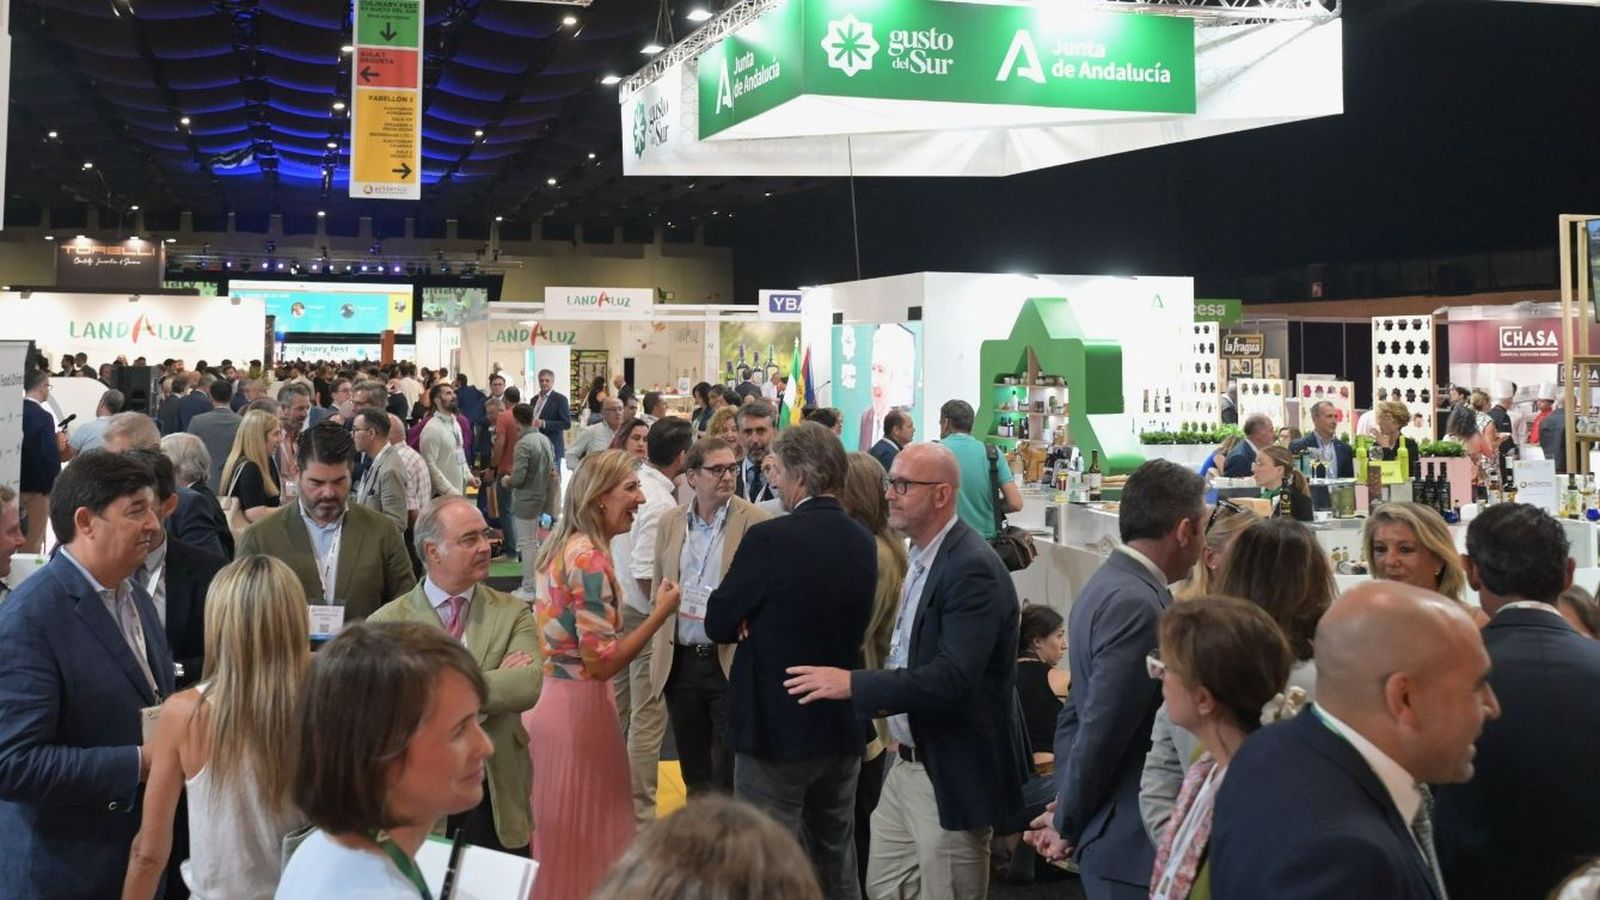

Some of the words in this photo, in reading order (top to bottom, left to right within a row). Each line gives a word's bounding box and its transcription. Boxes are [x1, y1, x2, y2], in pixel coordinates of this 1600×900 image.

[888, 27, 954, 56] gusto
[1052, 38, 1107, 58] Junta
[733, 51, 755, 75] Junta
[892, 57, 909, 69] del
[909, 50, 954, 74] Sur
[1052, 59, 1075, 78] de
[1079, 61, 1171, 84] Andalucía
[733, 78, 744, 98] de
[744, 56, 780, 94] Andalucía
[566, 291, 632, 307] LANDALUZ
[773, 297, 801, 311] YB
[1194, 303, 1226, 316] esa
[70, 313, 197, 343] LANDALUZ
[1503, 330, 1558, 346] CHASA
